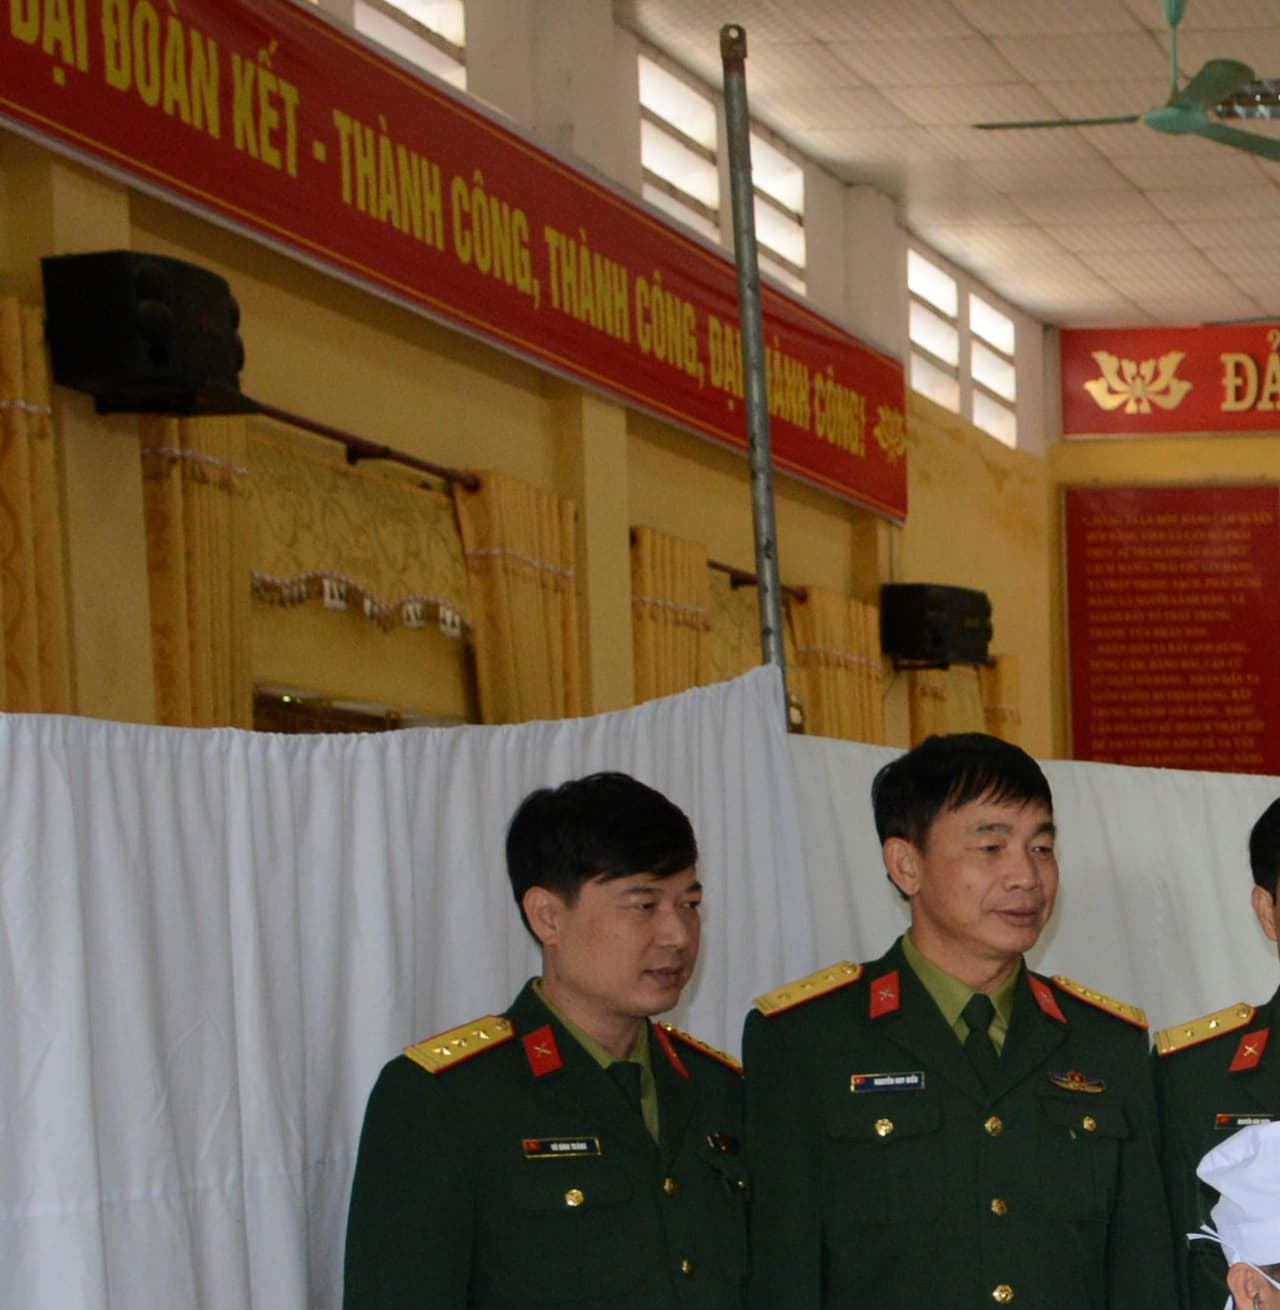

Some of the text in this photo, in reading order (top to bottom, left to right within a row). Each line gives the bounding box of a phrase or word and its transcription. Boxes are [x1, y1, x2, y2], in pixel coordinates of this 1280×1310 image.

[101, 0, 220, 139] ĐOÀN
[232, 39, 299, 178] KẾT
[333, 109, 445, 251] THÀNH
[452, 169, 541, 308] CÔNG,
[545, 226, 631, 344] THÀNH
[635, 271, 704, 387] CÔNG,
[815, 365, 866, 457] CÔNG!
